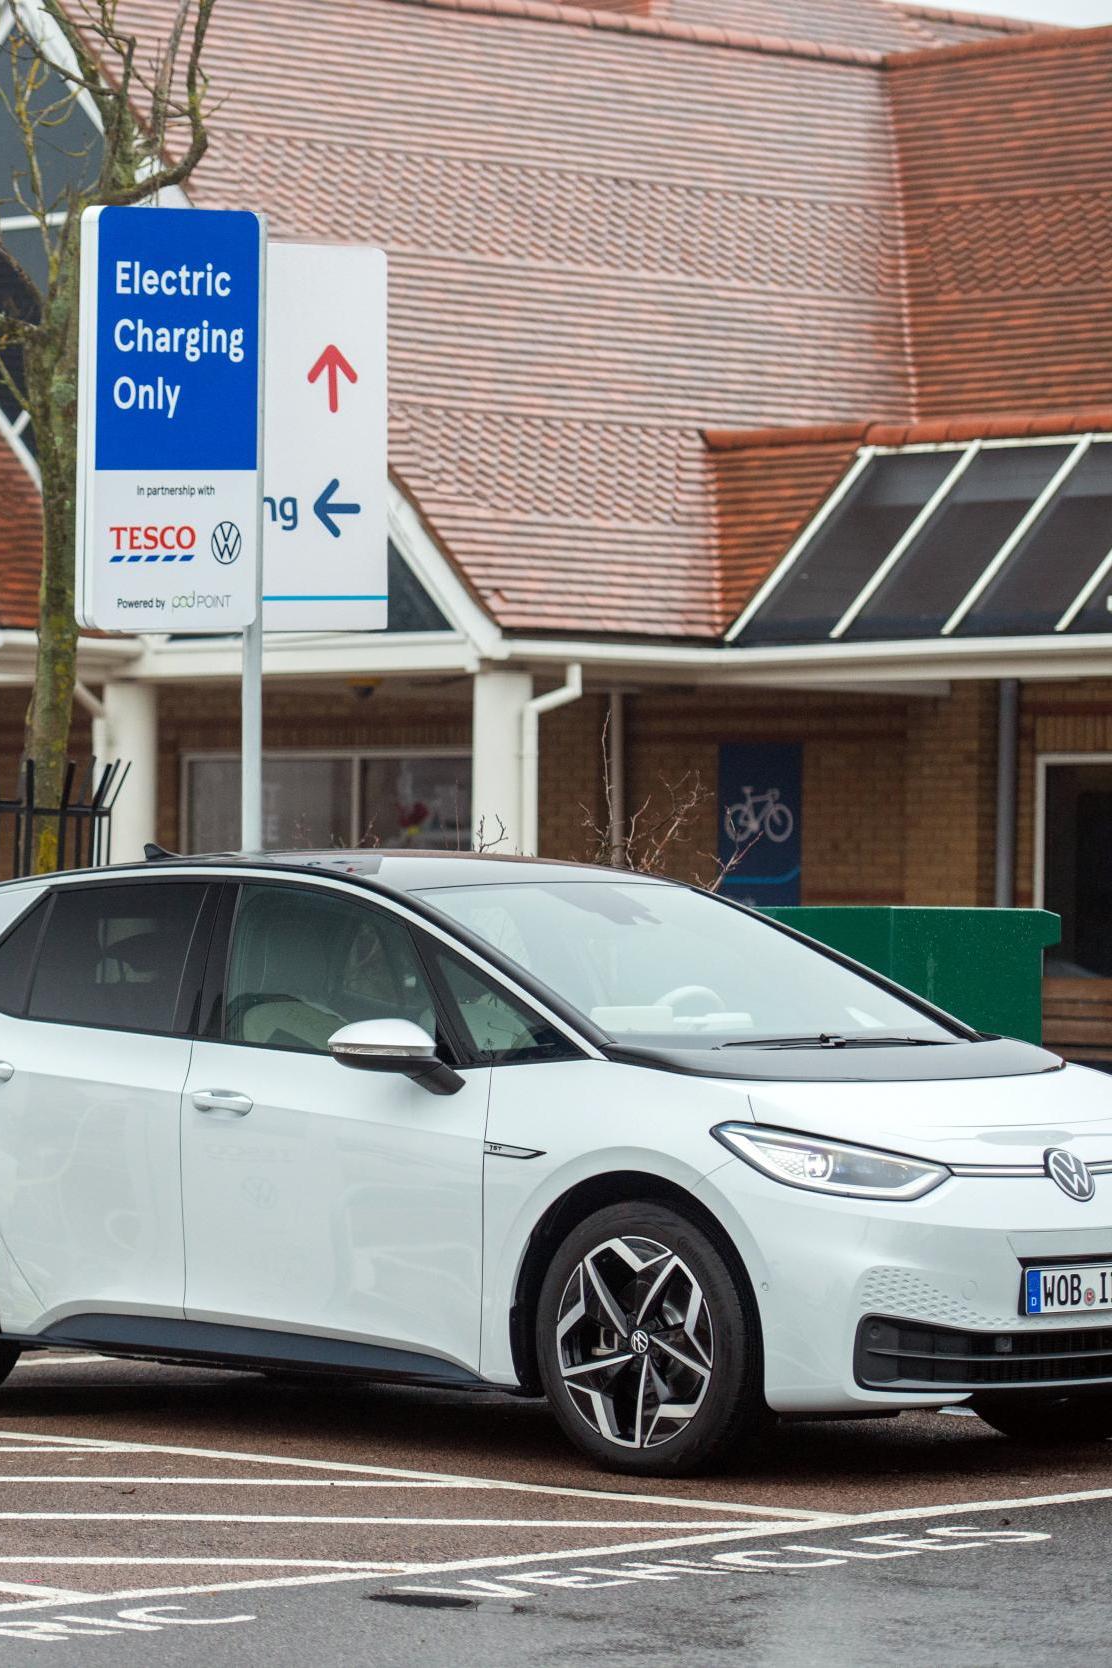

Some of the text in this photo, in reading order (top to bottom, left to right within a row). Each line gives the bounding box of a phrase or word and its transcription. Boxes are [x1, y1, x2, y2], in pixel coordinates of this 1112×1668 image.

[115, 260, 232, 297] Electric
[113, 318, 245, 363] Charging
[112, 376, 181, 419] Only
[136, 484, 216, 499] In partnership with
[263, 496, 298, 531] ng
[109, 525, 196, 550] TESCO
[116, 597, 154, 609] Powered
[155, 597, 166, 611] by
[197, 594, 232, 608] POINT
[1031, 1271, 1112, 1307] D WOB I
[392, 1525, 1052, 1599] VEHICLES
